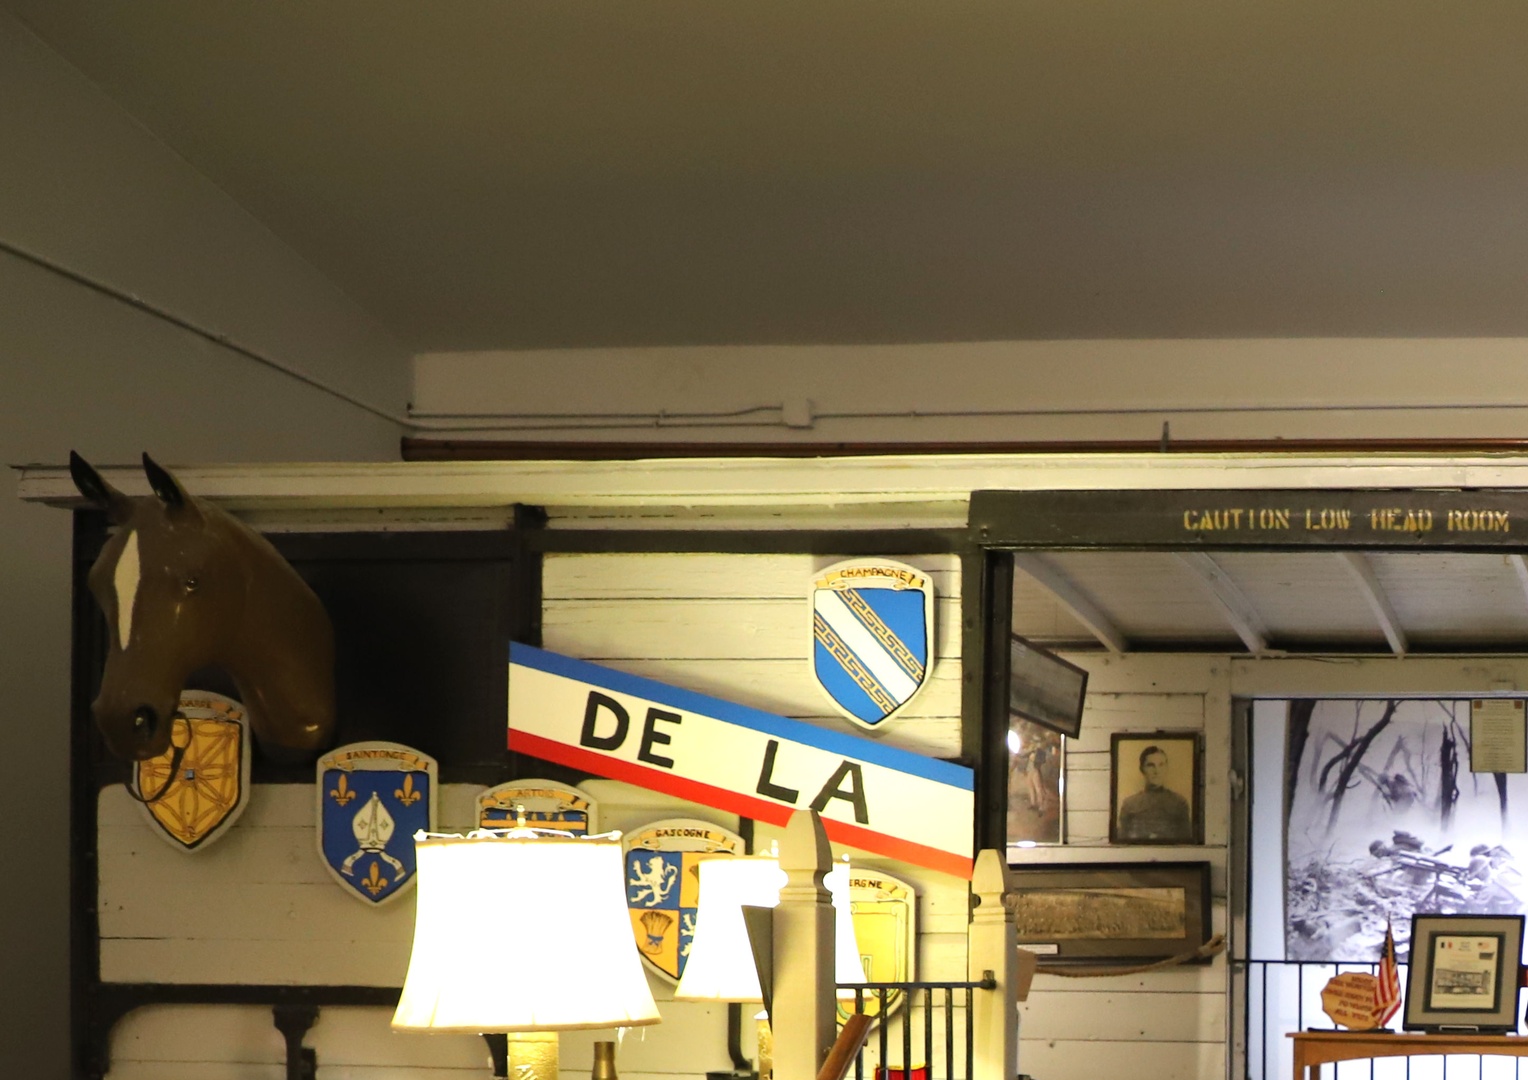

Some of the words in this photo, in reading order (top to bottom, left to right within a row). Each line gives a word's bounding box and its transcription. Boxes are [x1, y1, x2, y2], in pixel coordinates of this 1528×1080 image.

[1183, 508, 1290, 530] CAUTION
[1305, 508, 1350, 530] LOW
[1370, 508, 1433, 532] HEAD
[1446, 509, 1510, 533] ROOM
[840, 567, 907, 580] CHAMPAGNE
[346, 750, 406, 761] SAINTONGE
[580, 690, 682, 769] DE
[756, 739, 869, 825] LA
[516, 788, 556, 799] ARTOIS
[655, 828, 711, 839] GASCOGNE
